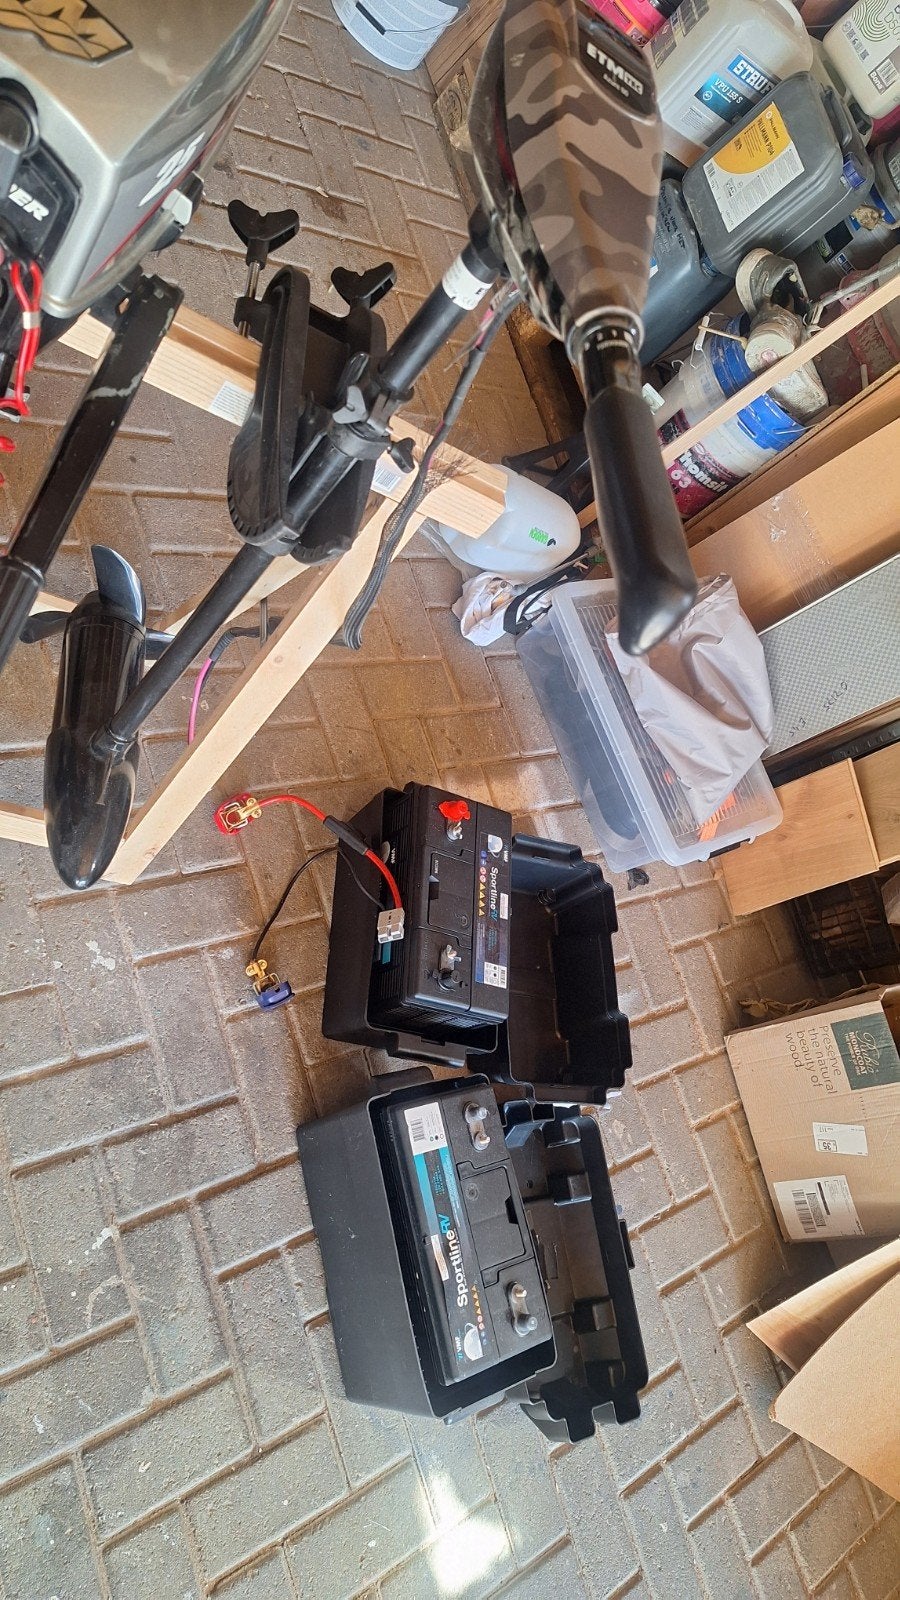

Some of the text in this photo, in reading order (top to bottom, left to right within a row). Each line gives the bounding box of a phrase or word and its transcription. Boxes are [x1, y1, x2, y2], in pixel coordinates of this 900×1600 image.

[714, 78, 730, 94] VPU
[736, 96, 743, 104] S
[870, 71, 884, 90] Bona
[679, 451, 729, 494] homsit
[785, 1032, 804, 1072] wood.
[796, 1030, 823, 1088] beauty of
[807, 1028, 838, 1094] the natural
[819, 1025, 842, 1077] Preserve
[848, 1032, 867, 1075] MONOCOAT
[855, 1031, 879, 1074] Rubio
[823, 1142, 831, 1150] 35
